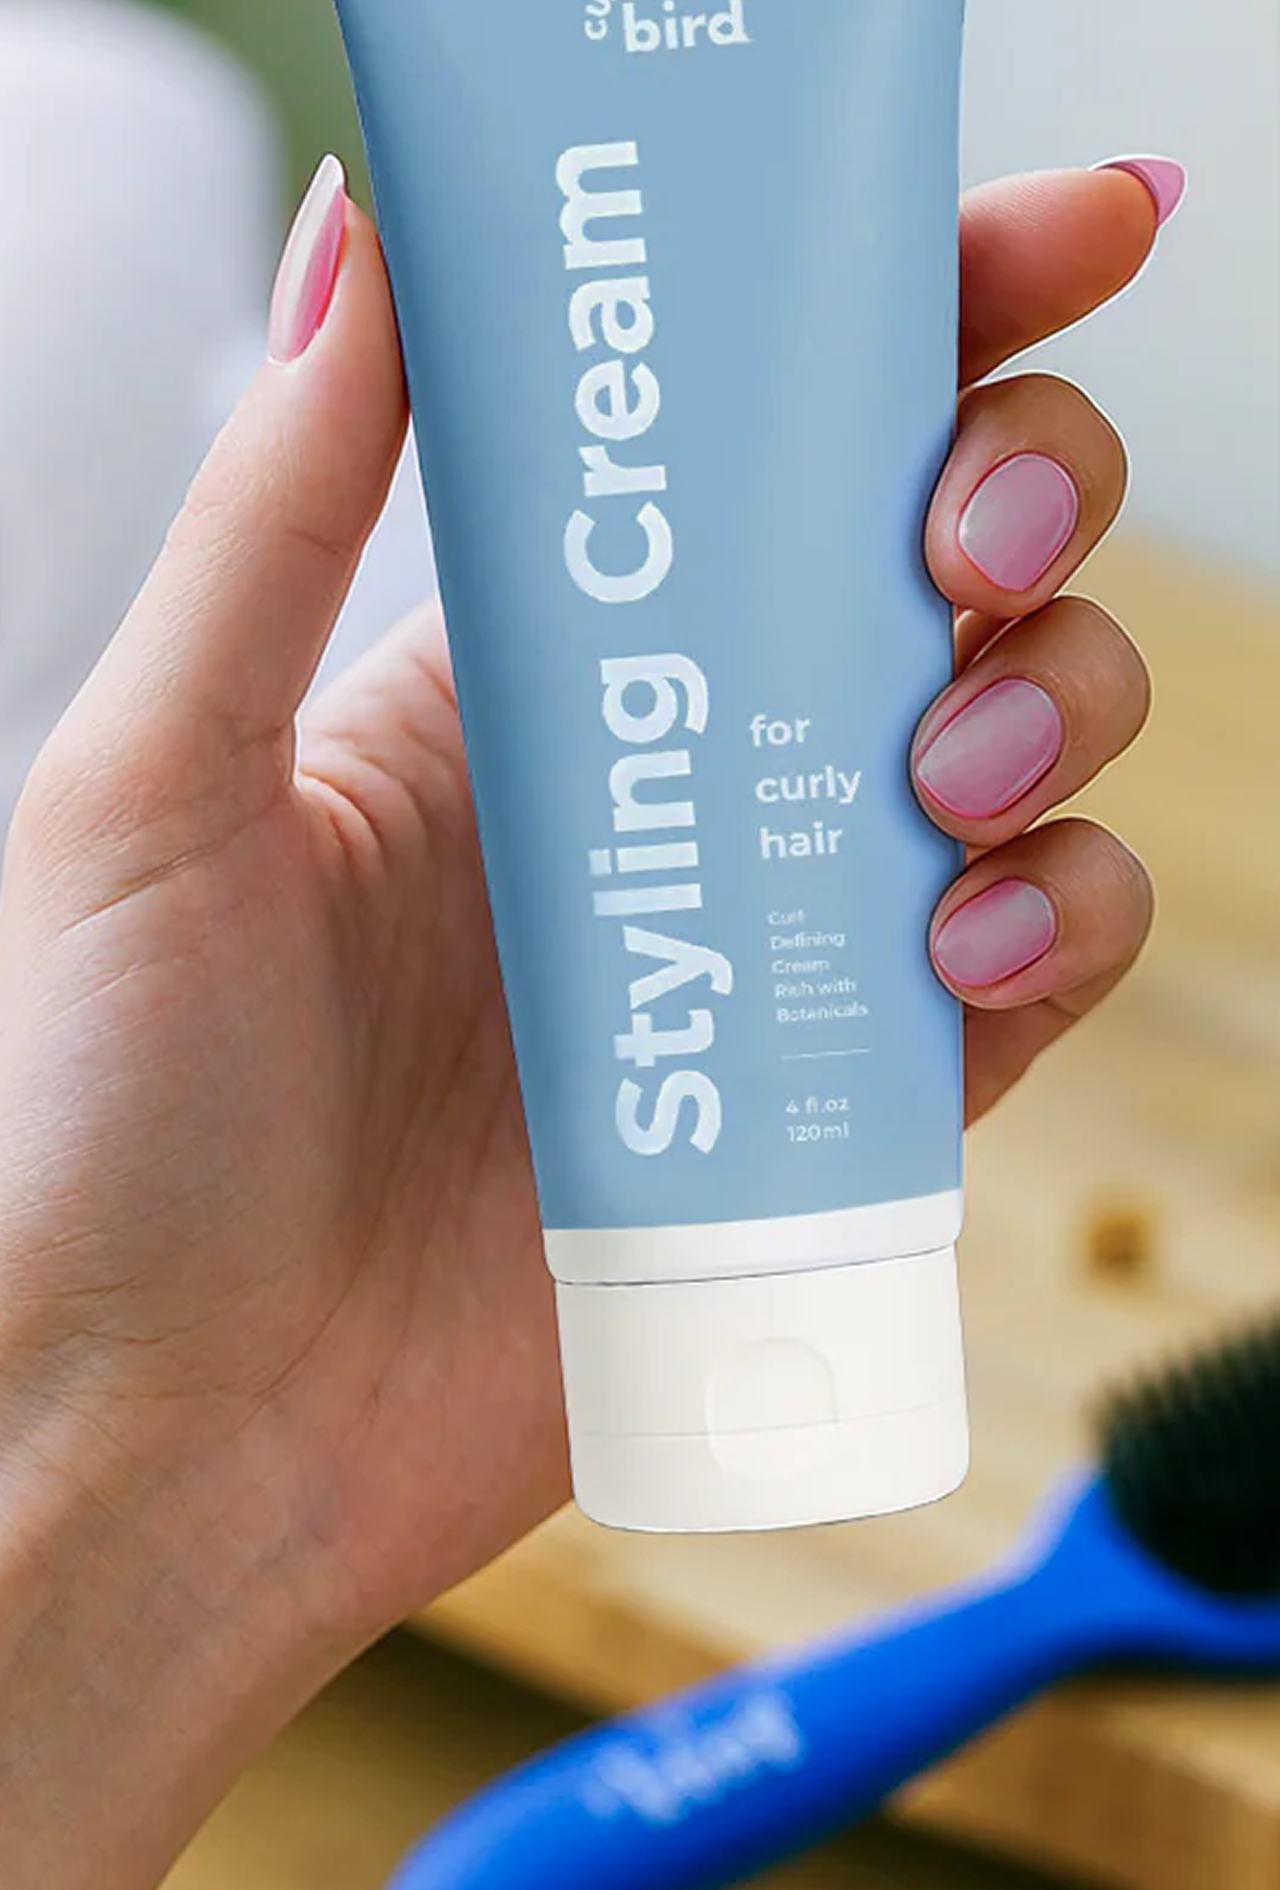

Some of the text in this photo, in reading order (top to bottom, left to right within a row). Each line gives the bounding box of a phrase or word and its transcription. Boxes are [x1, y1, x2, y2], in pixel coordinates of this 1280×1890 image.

[622, 0, 752, 52] bird
[555, 140, 733, 1155] Styling Cream
[749, 714, 811, 747] for
[754, 764, 862, 804] curly
[759, 821, 843, 859] hair
[770, 931, 846, 951] Defining
[771, 958, 831, 975] Cream
[775, 977, 857, 999] Rich with
[776, 1001, 870, 1023] Botanicals
[785, 1098, 800, 1115] 4
